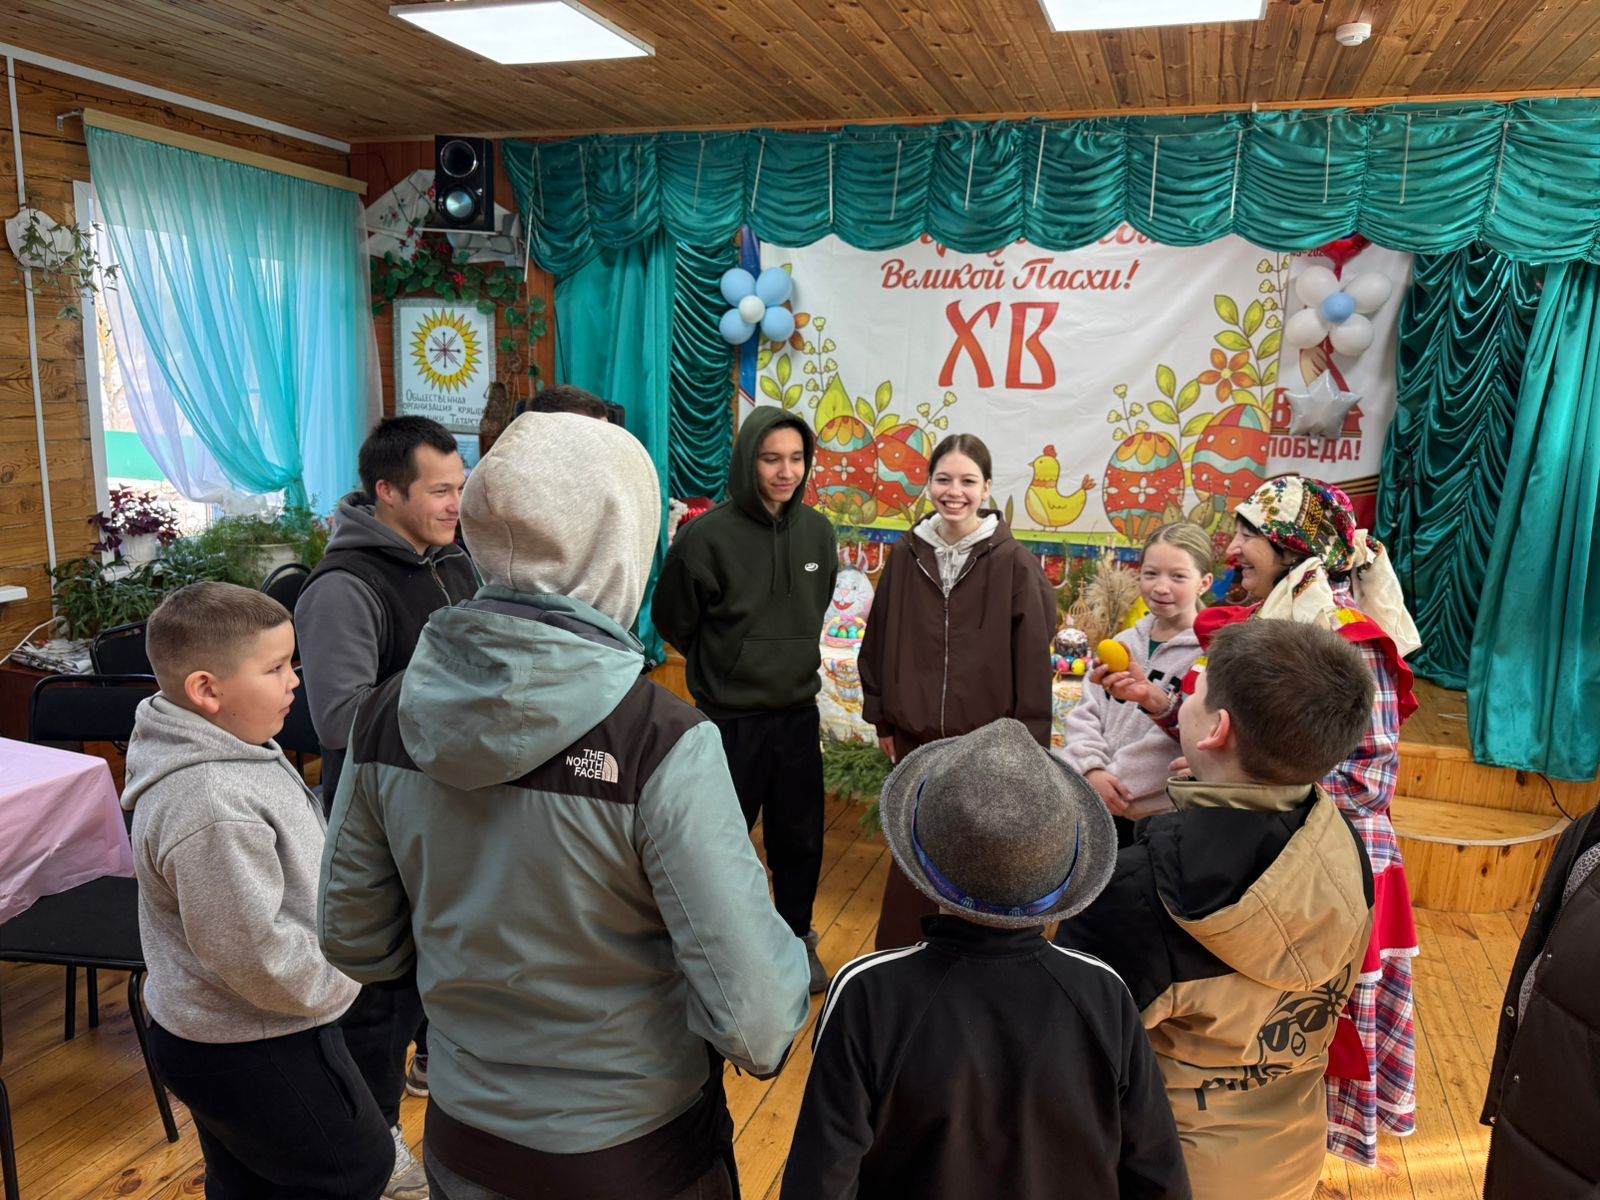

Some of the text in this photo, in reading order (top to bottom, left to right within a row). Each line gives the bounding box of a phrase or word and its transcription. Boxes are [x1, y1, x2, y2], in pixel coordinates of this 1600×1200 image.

[881, 257, 1141, 290] Великой Пасхи!
[938, 299, 1059, 390] ХВ
[449, 413, 480, 425] ТАТАРСТ
[1270, 436, 1361, 463] ПОБЕДА!
[583, 748, 605, 760] THE
[565, 755, 603, 770] NORTH
[574, 766, 602, 780] FACE
